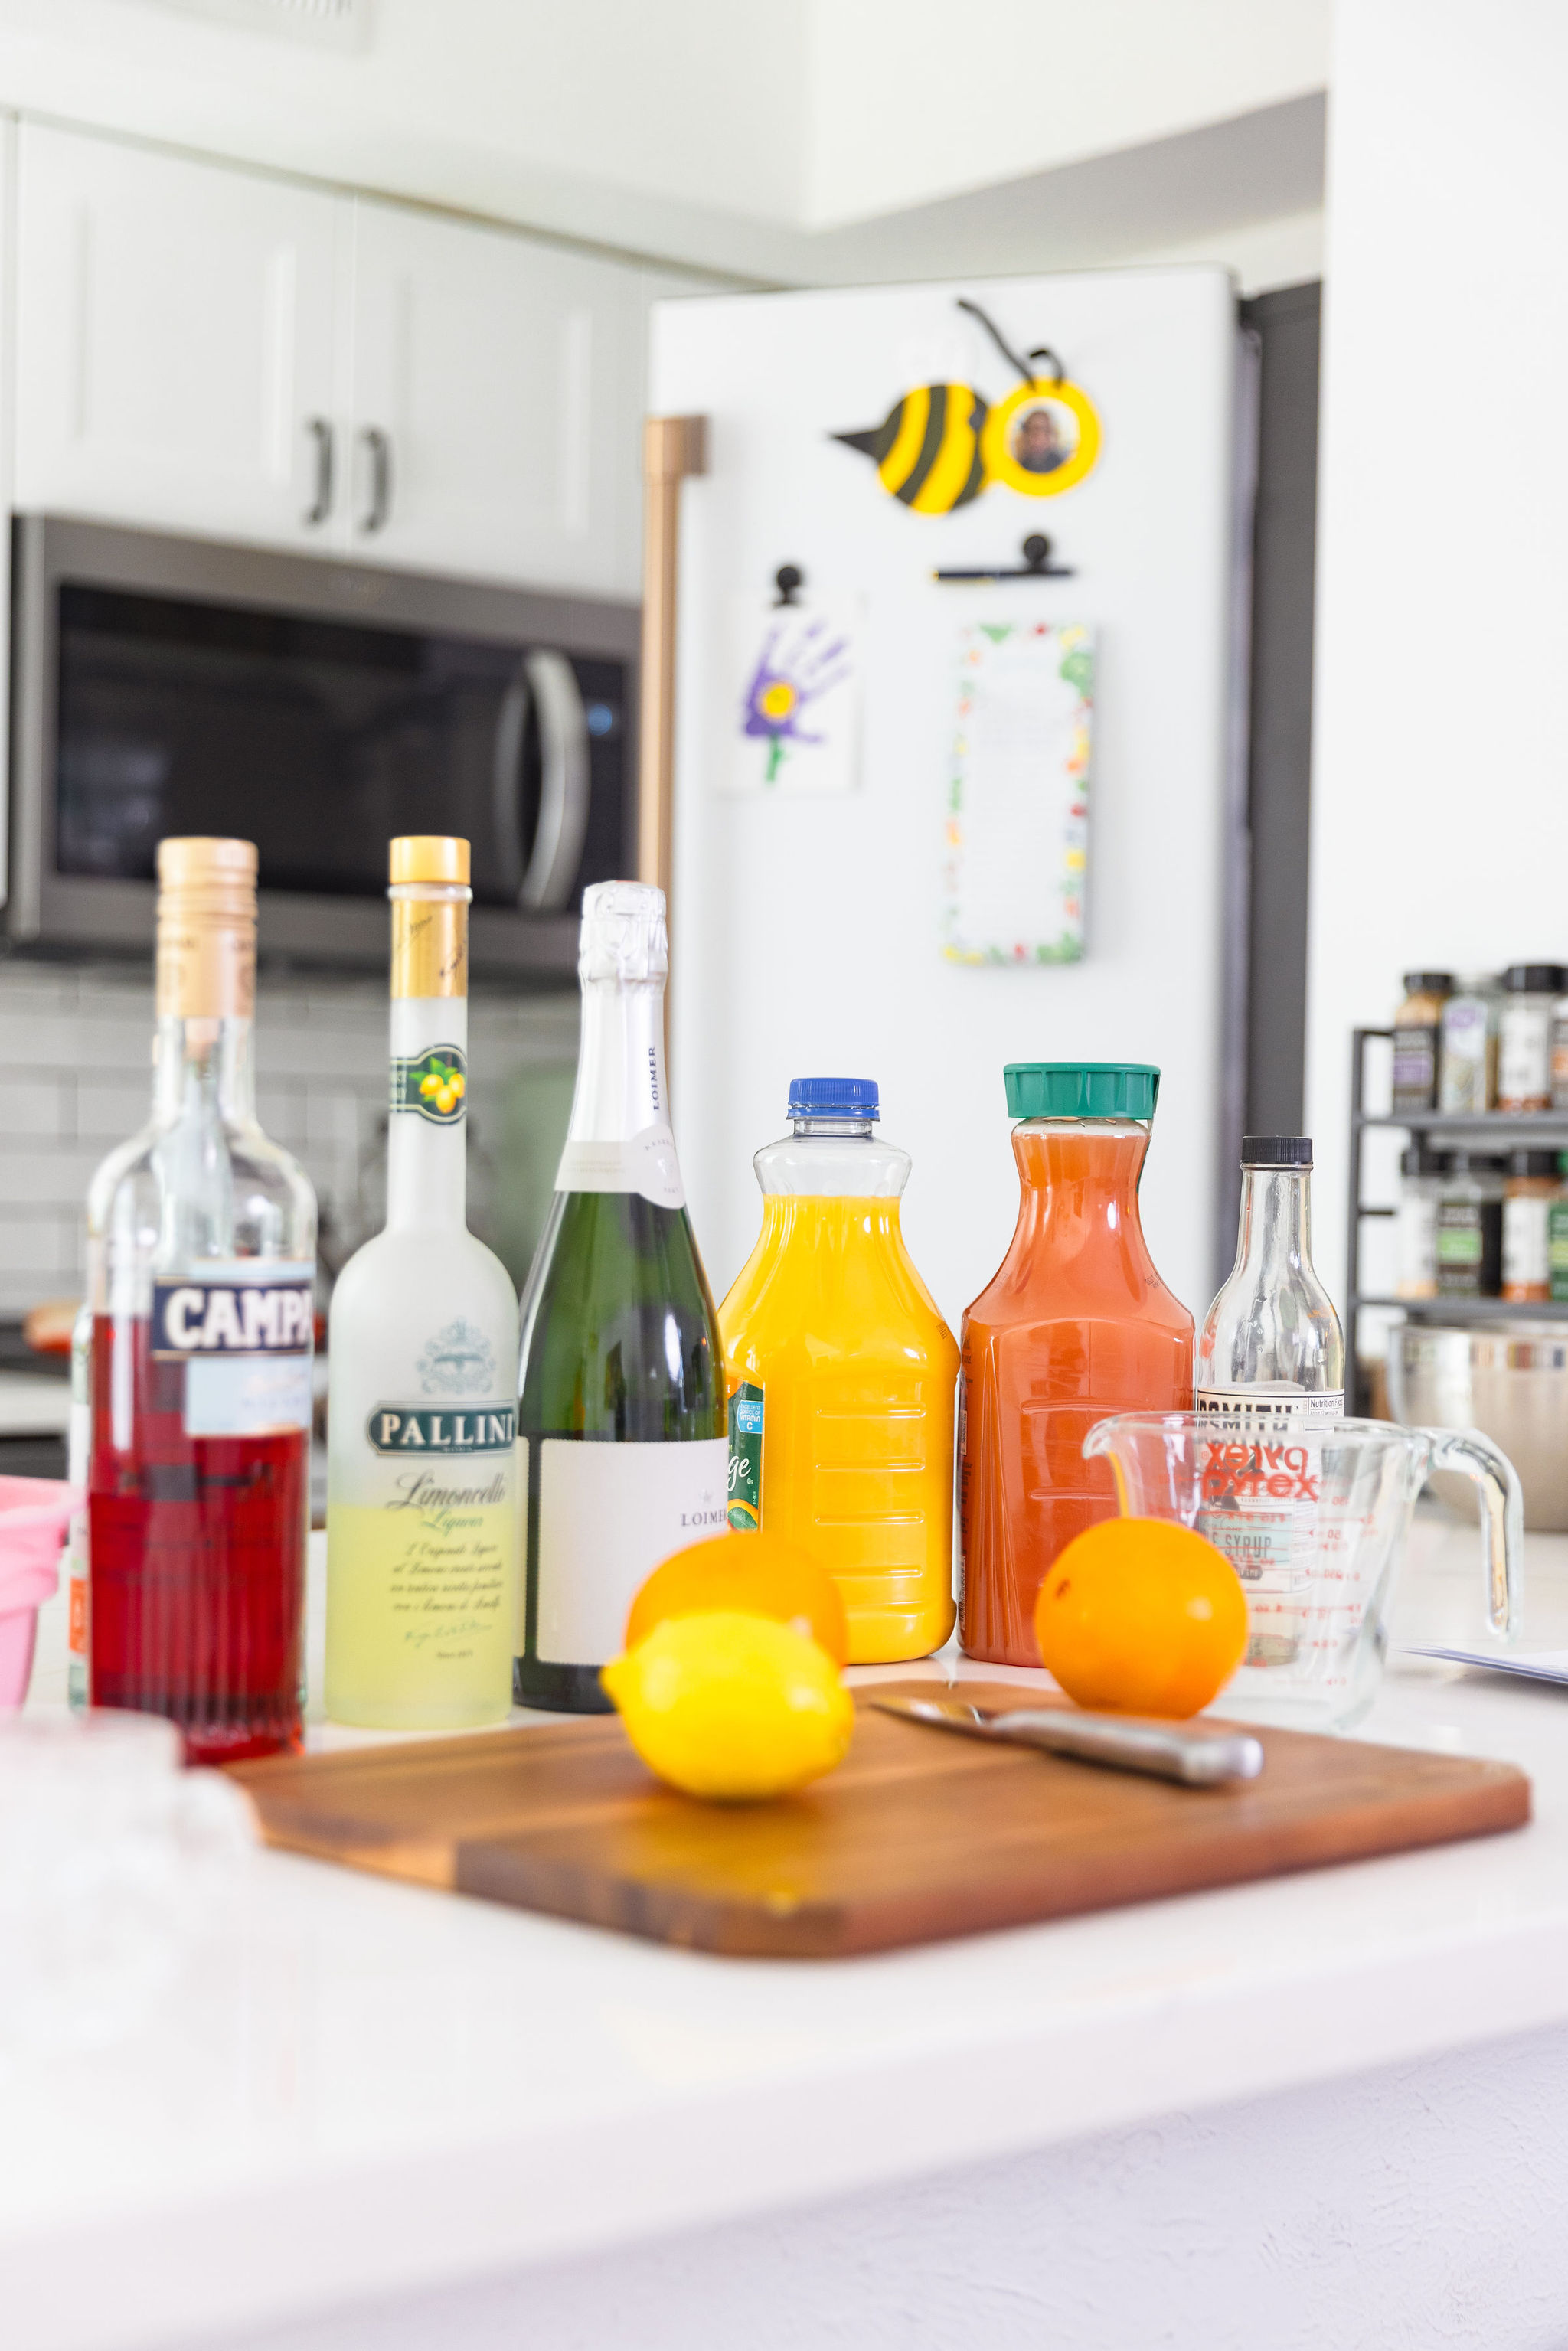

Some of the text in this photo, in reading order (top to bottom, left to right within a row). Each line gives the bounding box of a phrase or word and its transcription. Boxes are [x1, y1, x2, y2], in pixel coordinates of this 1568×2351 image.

[648, 1046, 659, 1110] LOIMER
[1310, 1398, 1334, 1409] Nutrition
[740, 1415, 761, 1423] VITAMIN
[746, 1422, 753, 1431] C
[380, 1413, 514, 1445] PALLINI
[1225, 1533, 1272, 1559] SYRUP
